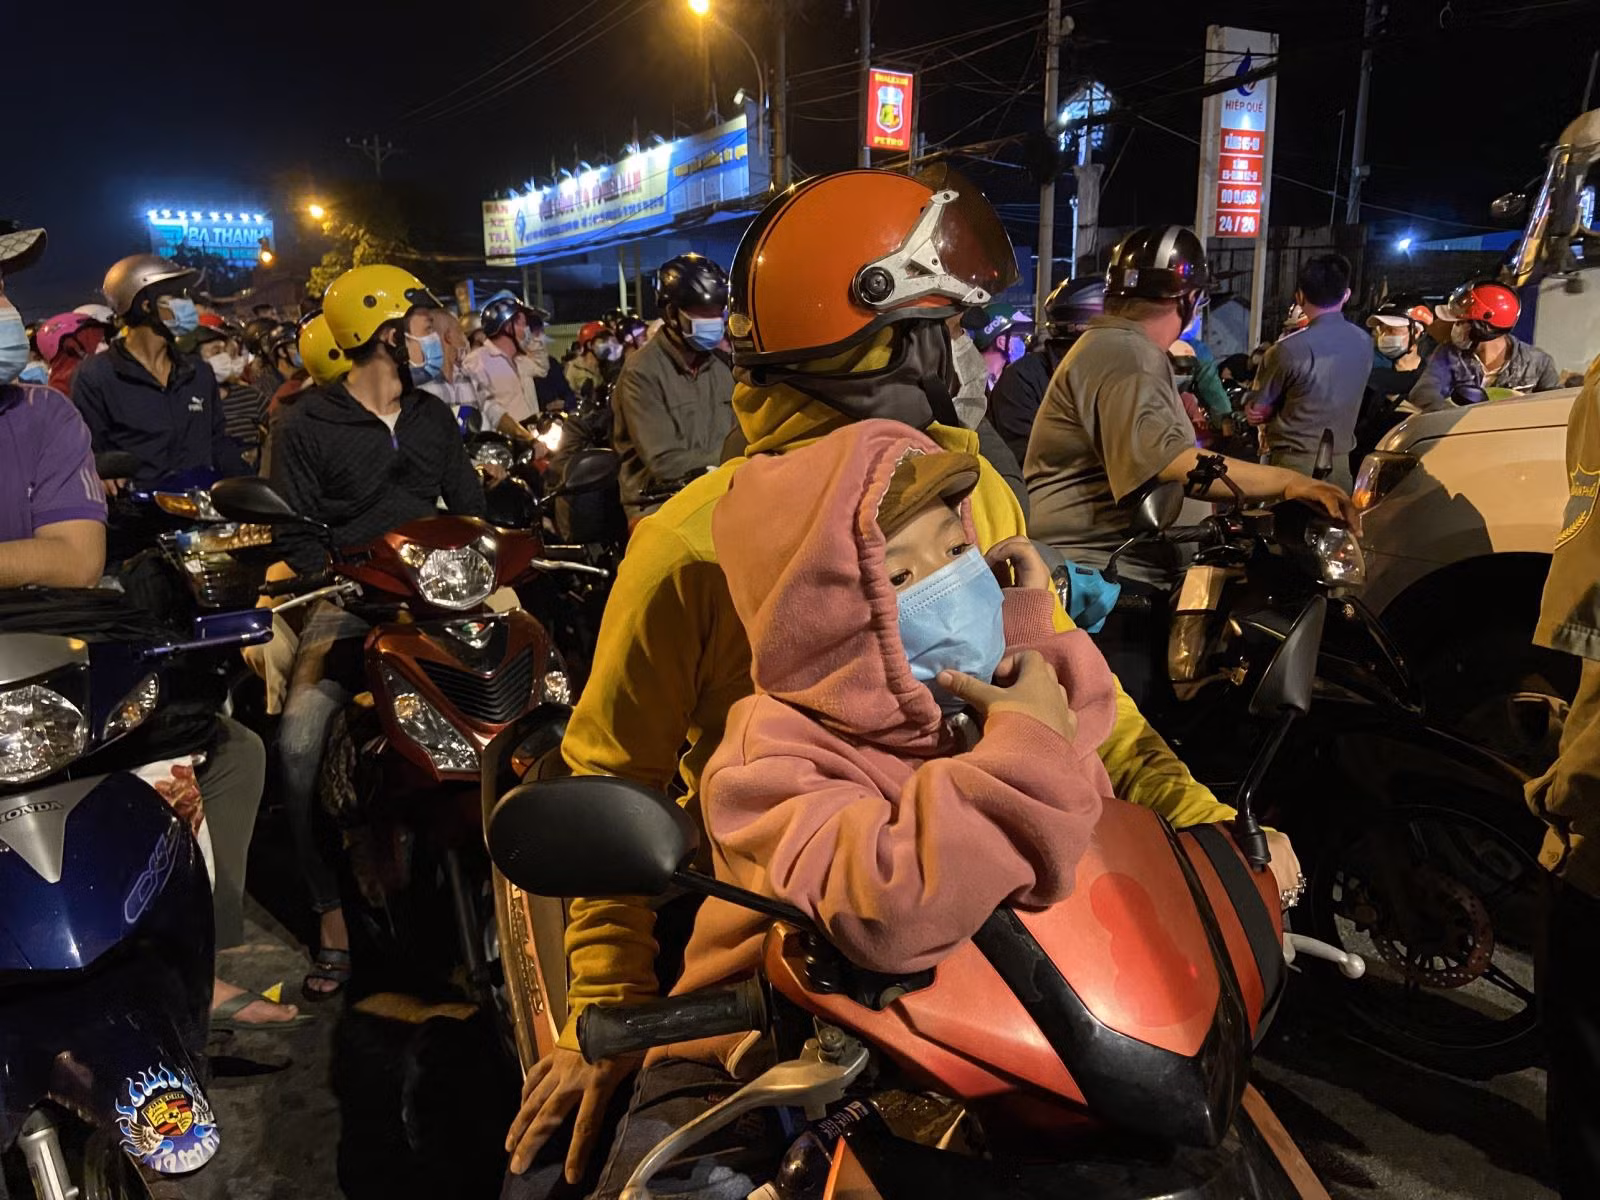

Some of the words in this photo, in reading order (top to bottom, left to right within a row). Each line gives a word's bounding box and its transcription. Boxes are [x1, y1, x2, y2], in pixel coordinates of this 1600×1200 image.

[873, 136, 904, 146] PETRO
[1218, 215, 1233, 232] 24
[1240, 215, 1256, 233] 24
[983, 315, 1008, 335] Grab
